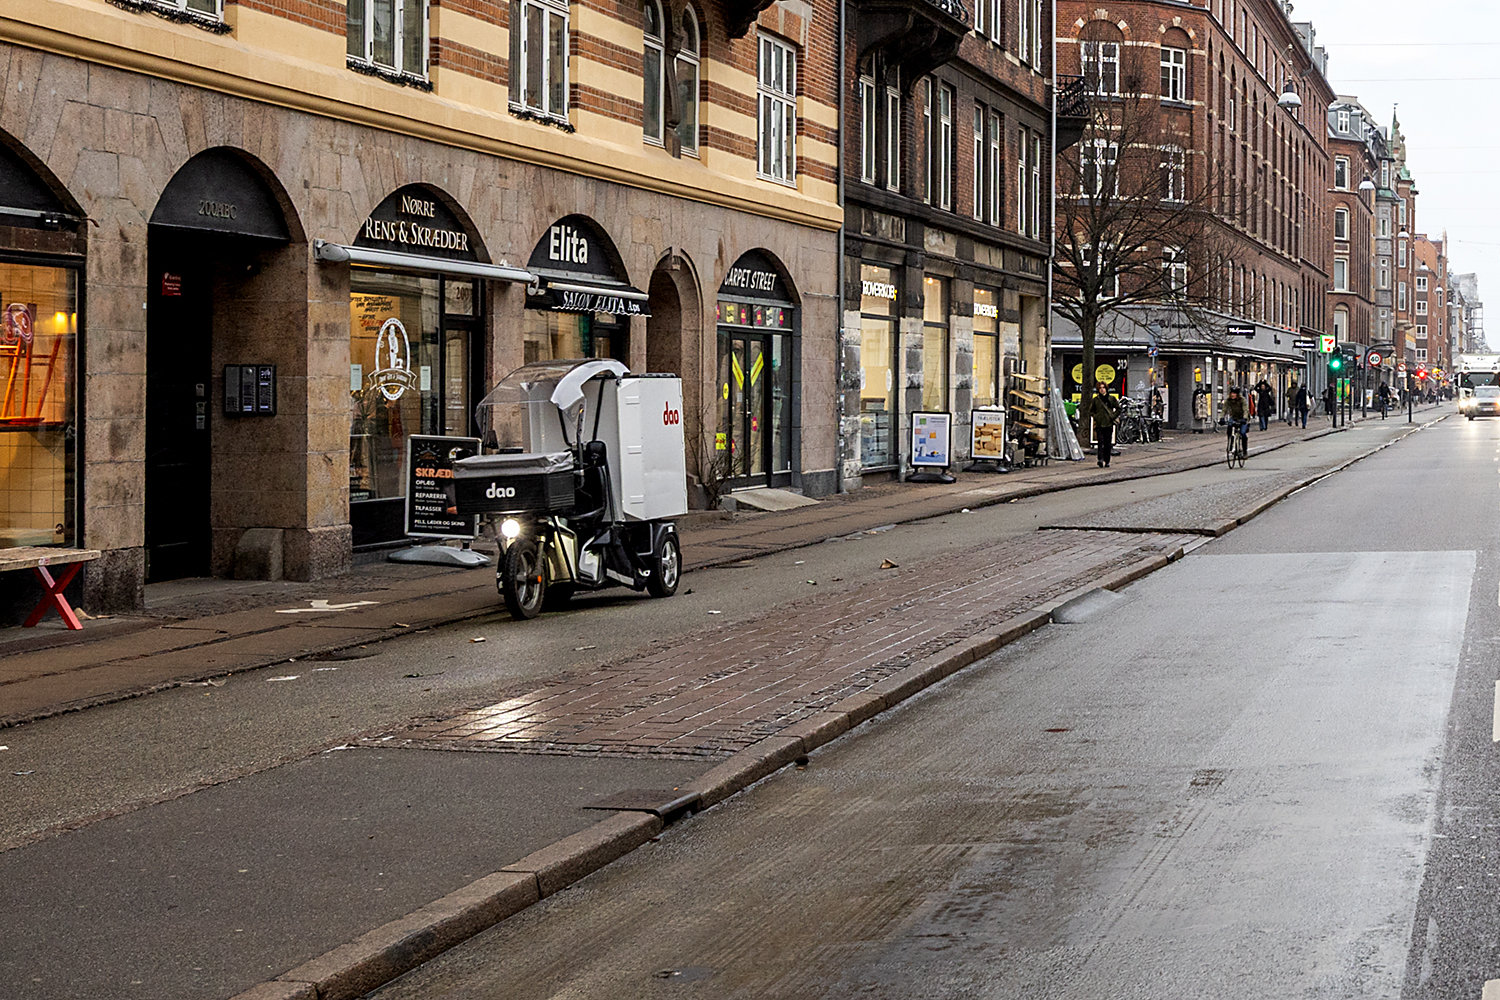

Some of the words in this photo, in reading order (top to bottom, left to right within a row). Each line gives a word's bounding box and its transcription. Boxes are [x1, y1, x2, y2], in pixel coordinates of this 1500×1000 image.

[402, 195, 435, 218] NØRRE
[365, 217, 396, 242] RENS
[399, 221, 409, 243] &
[411, 222, 469, 251] SKRÆDDER
[549, 225, 588, 264] Elita
[724, 267, 751, 288] CARPET
[750, 271, 777, 291] STREET
[563, 291, 593, 309] SALON
[594, 295, 625, 313] ELITA
[663, 401, 680, 425] dao
[415, 467, 455, 479] SKRÆD
[415, 492, 447, 500] REPARERER
[485, 482, 516, 499] dao
